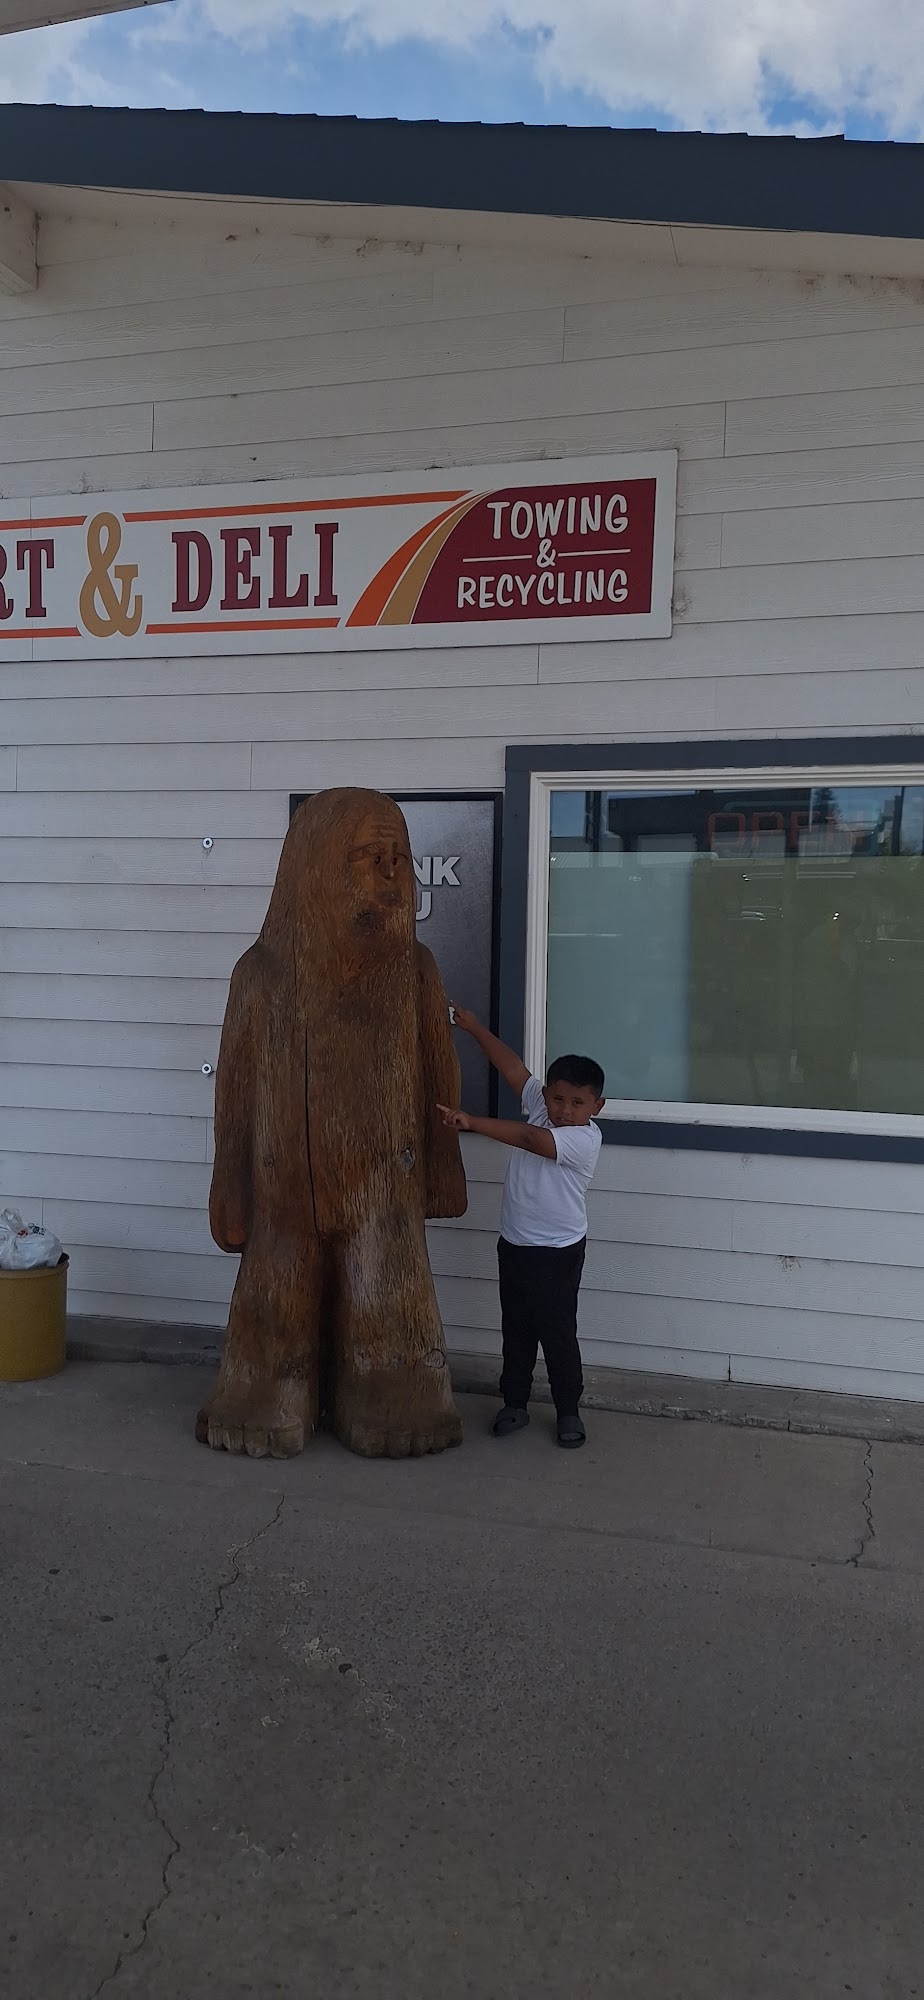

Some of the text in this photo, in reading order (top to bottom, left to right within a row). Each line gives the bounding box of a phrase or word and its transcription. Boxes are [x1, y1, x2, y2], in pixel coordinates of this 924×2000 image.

[486, 494, 629, 540] TOWING
[536, 538, 556, 568] &
[79, 511, 143, 638] &
[171, 522, 339, 613] DELI
[457, 569, 629, 609] RECYCLING
[707, 811, 866, 850] OPEN
